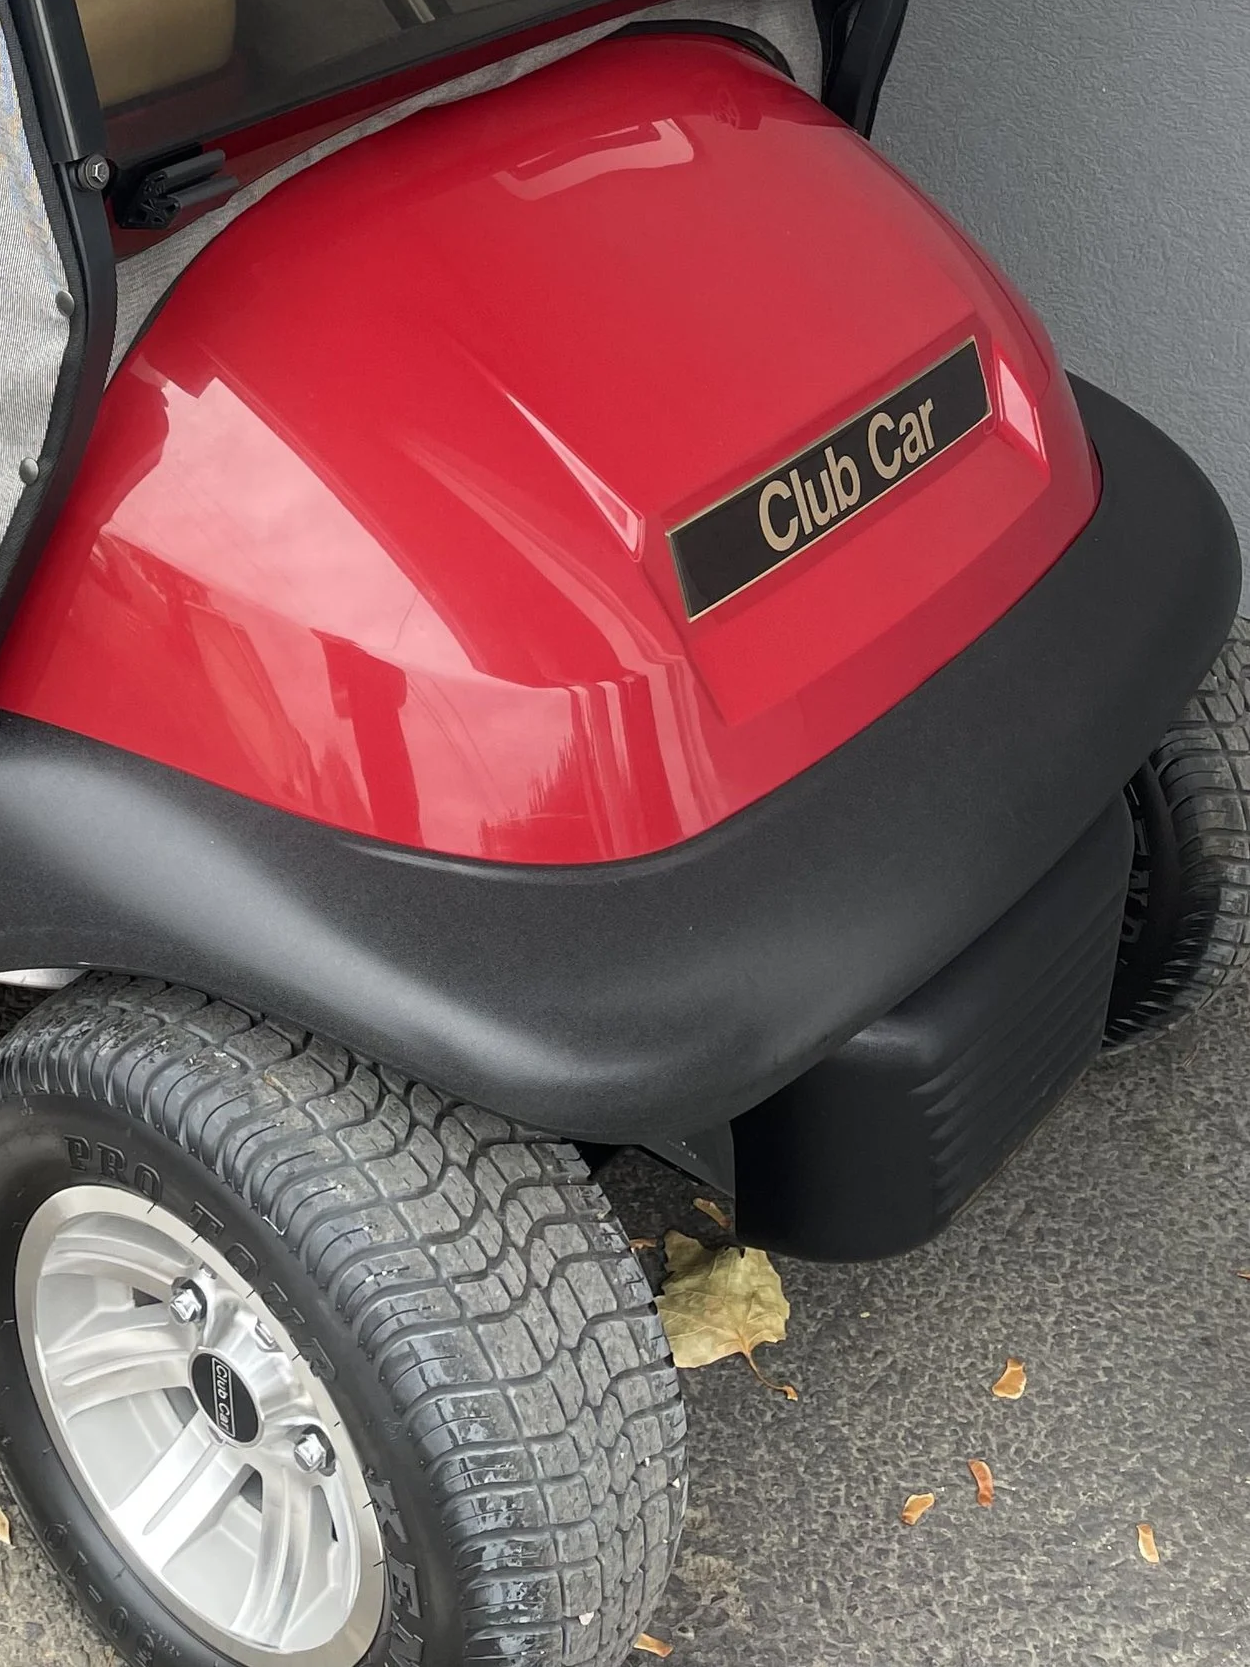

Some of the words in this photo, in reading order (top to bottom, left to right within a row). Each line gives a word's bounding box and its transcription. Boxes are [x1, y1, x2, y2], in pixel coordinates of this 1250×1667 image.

[759, 446, 862, 552] Club
[867, 398, 936, 480] Car
[63, 1135, 162, 1203] PRO
[216, 1364, 229, 1400] Club
[218, 1402, 230, 1431] Car
